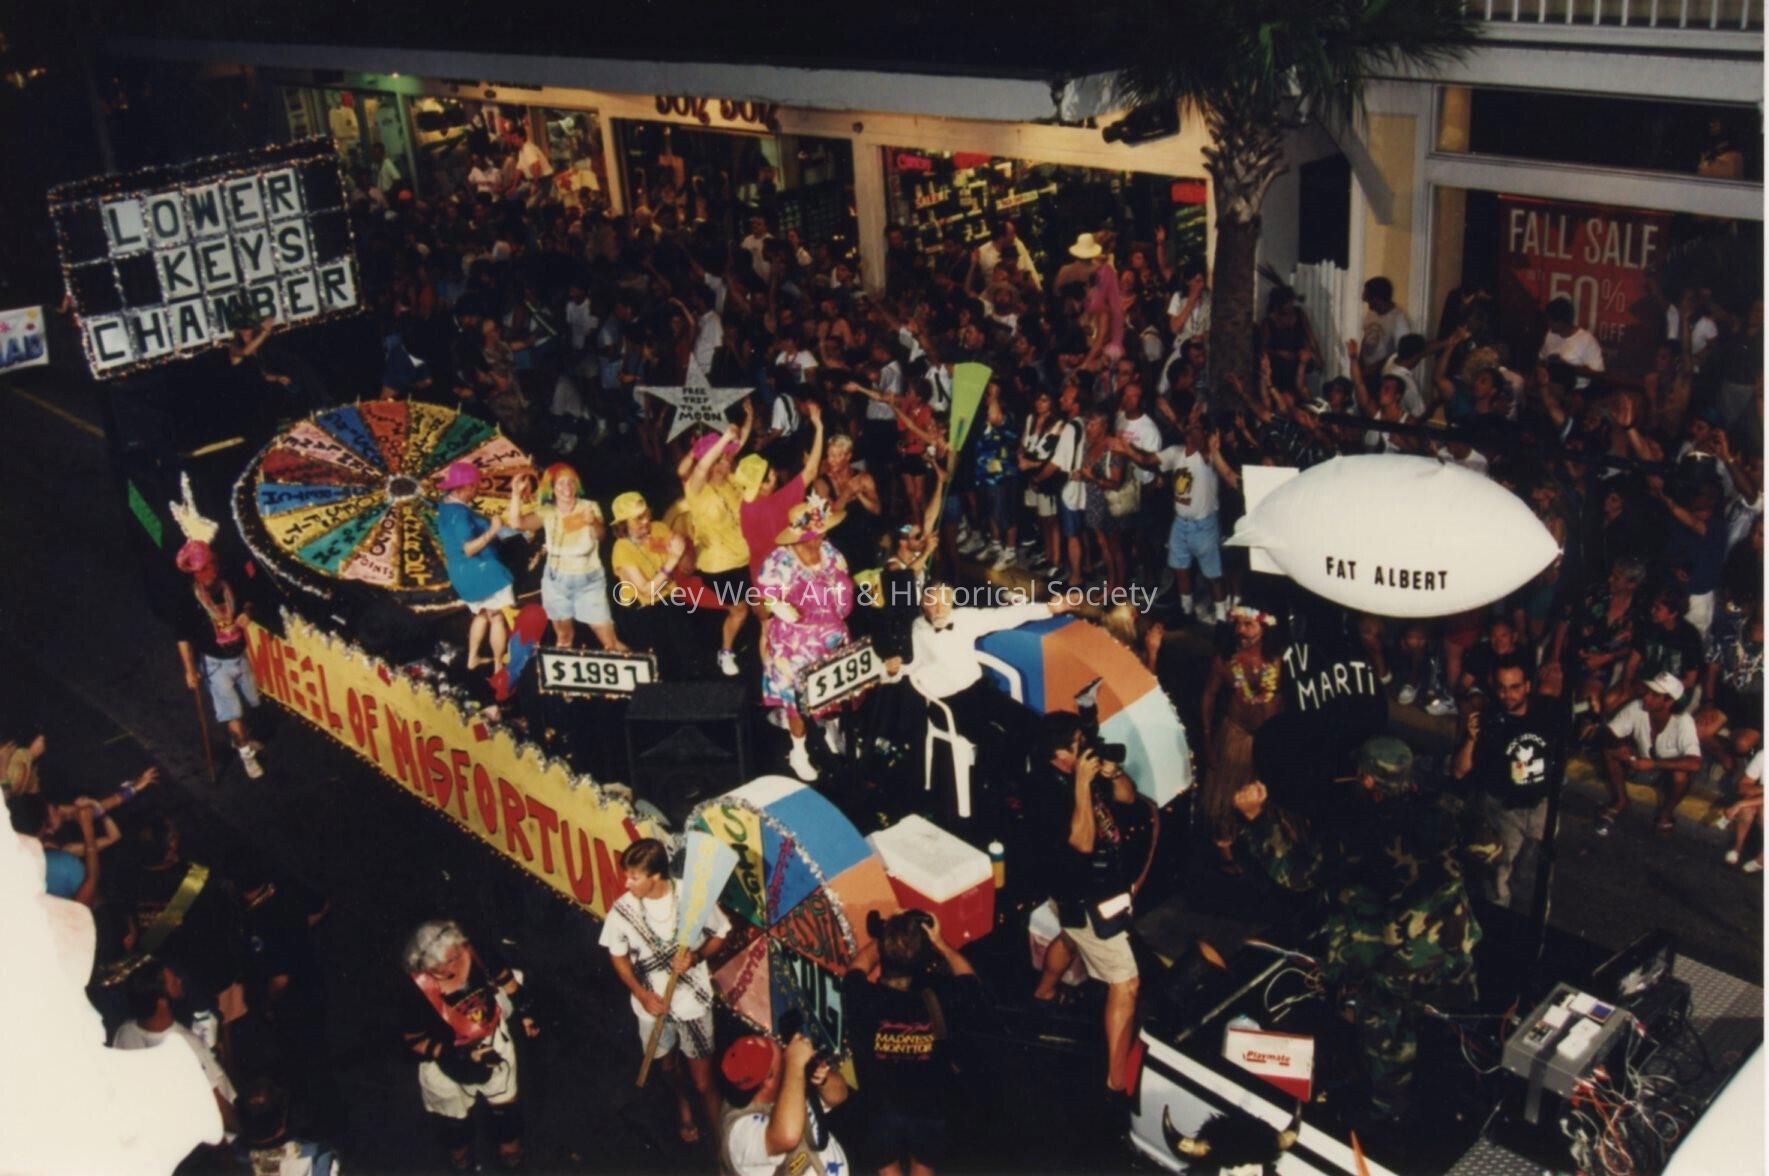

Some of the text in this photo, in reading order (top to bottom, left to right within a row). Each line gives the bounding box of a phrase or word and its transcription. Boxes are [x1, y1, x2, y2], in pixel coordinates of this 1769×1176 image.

[107, 172, 295, 247] LOWER
[1509, 208, 1573, 260] FALL
[162, 226, 304, 291] KEYS
[93, 266, 348, 362] CHAMBER
[678, 411, 722, 421] MOON
[682, 387, 706, 396] FREE
[1326, 556, 1448, 591] FAT ALBERT
[1283, 643, 1309, 678] TV
[246, 628, 342, 729] WHEEL
[347, 687, 379, 763] OF
